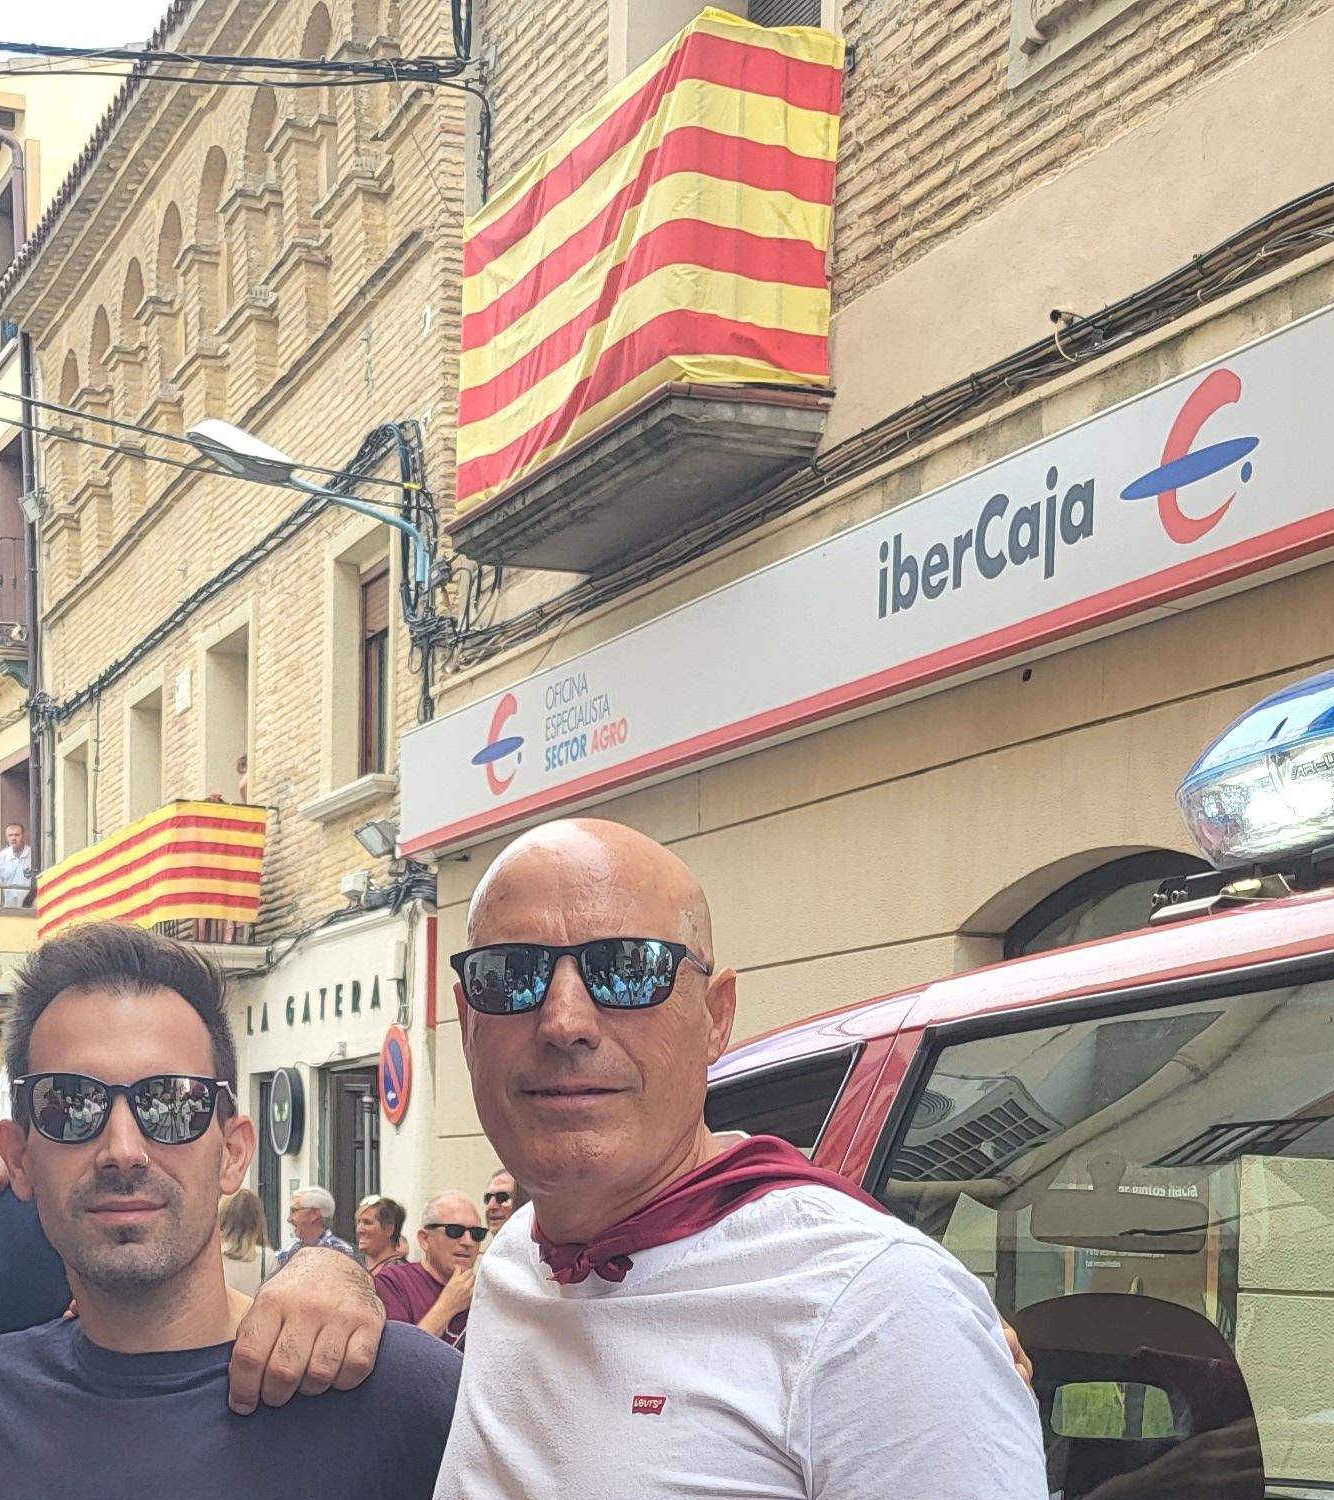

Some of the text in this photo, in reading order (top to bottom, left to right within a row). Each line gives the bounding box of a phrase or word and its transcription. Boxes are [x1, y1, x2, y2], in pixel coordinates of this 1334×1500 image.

[878, 466, 1095, 619] iberCaja
[545, 672, 589, 711] OFICINA
[545, 694, 611, 742] ESPECIALISTA
[545, 718, 628, 771] SECTOR AGRO
[247, 975, 381, 1036] LA GATERA
